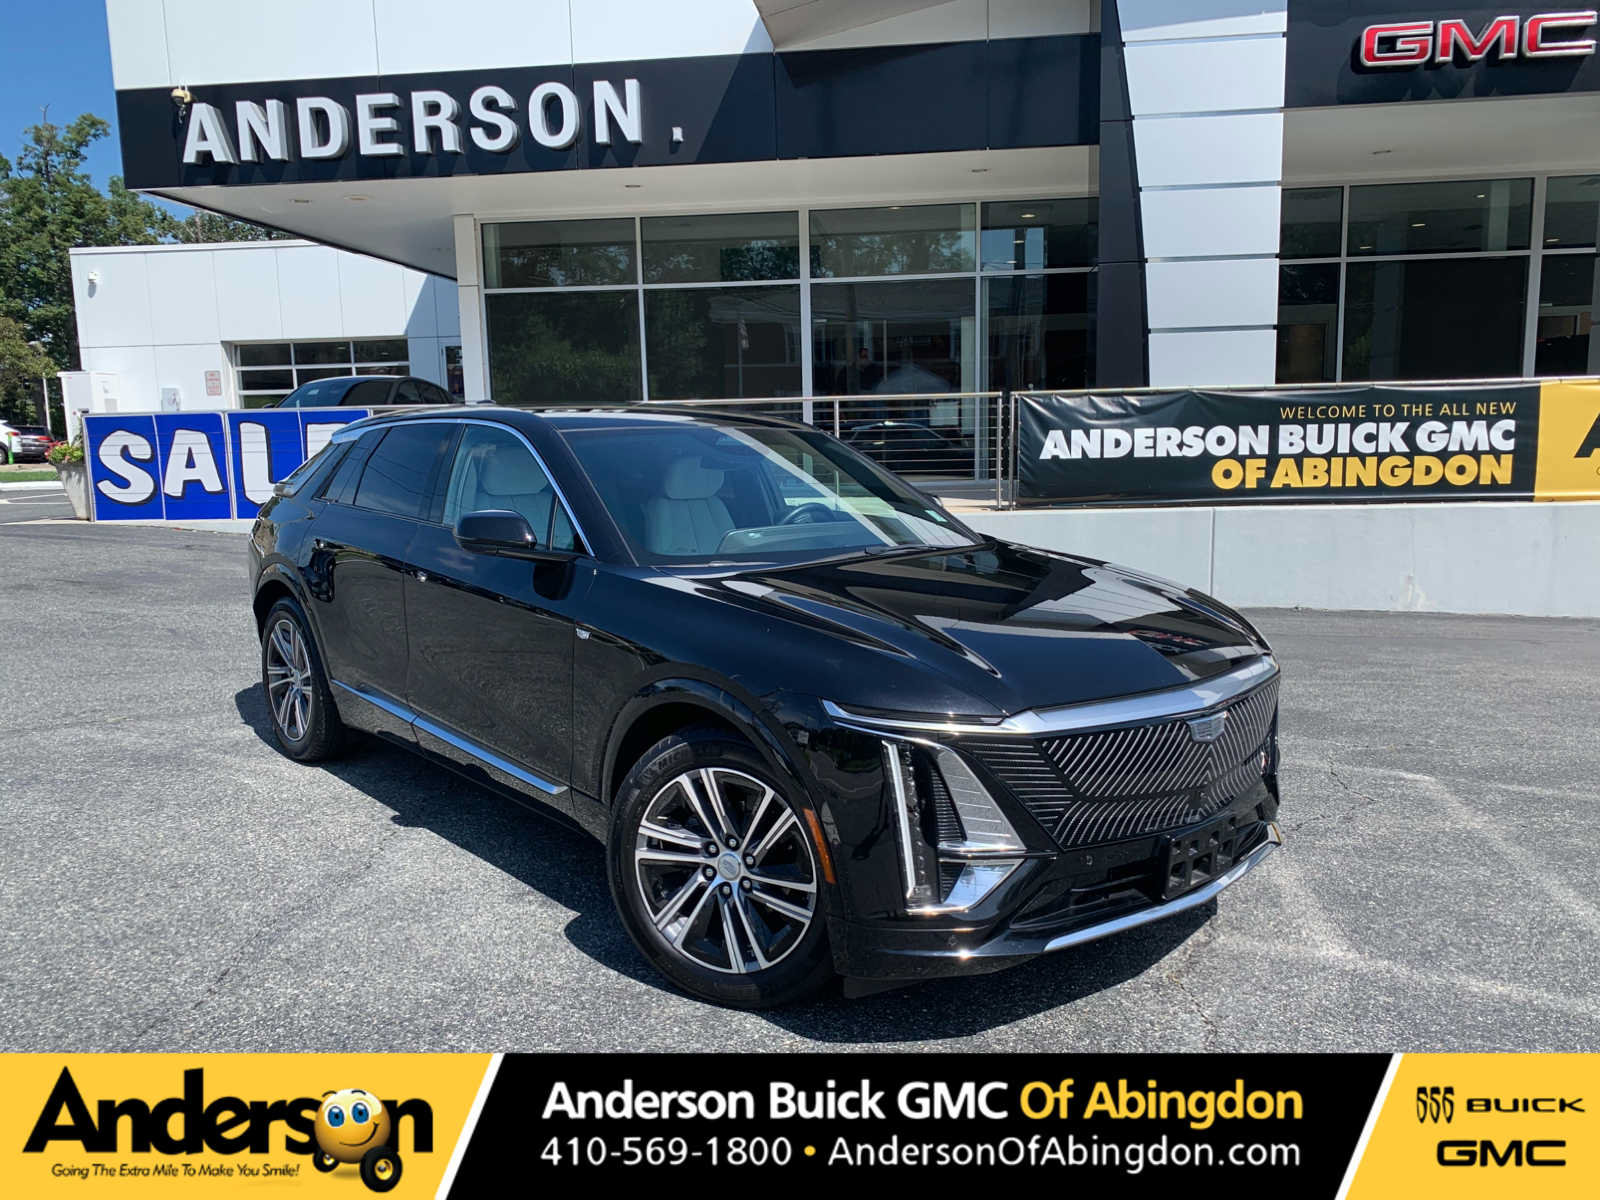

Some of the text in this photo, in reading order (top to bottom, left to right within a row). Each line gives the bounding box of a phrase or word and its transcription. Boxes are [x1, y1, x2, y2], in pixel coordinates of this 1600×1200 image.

[1361, 10, 1598, 67] GMC
[1279, 401, 1518, 419] WELCOME TO THE ALL NEW
[1039, 418, 1516, 460] ANDERSON BUICK GMC
[1211, 453, 1514, 490] OF ABINGDON
